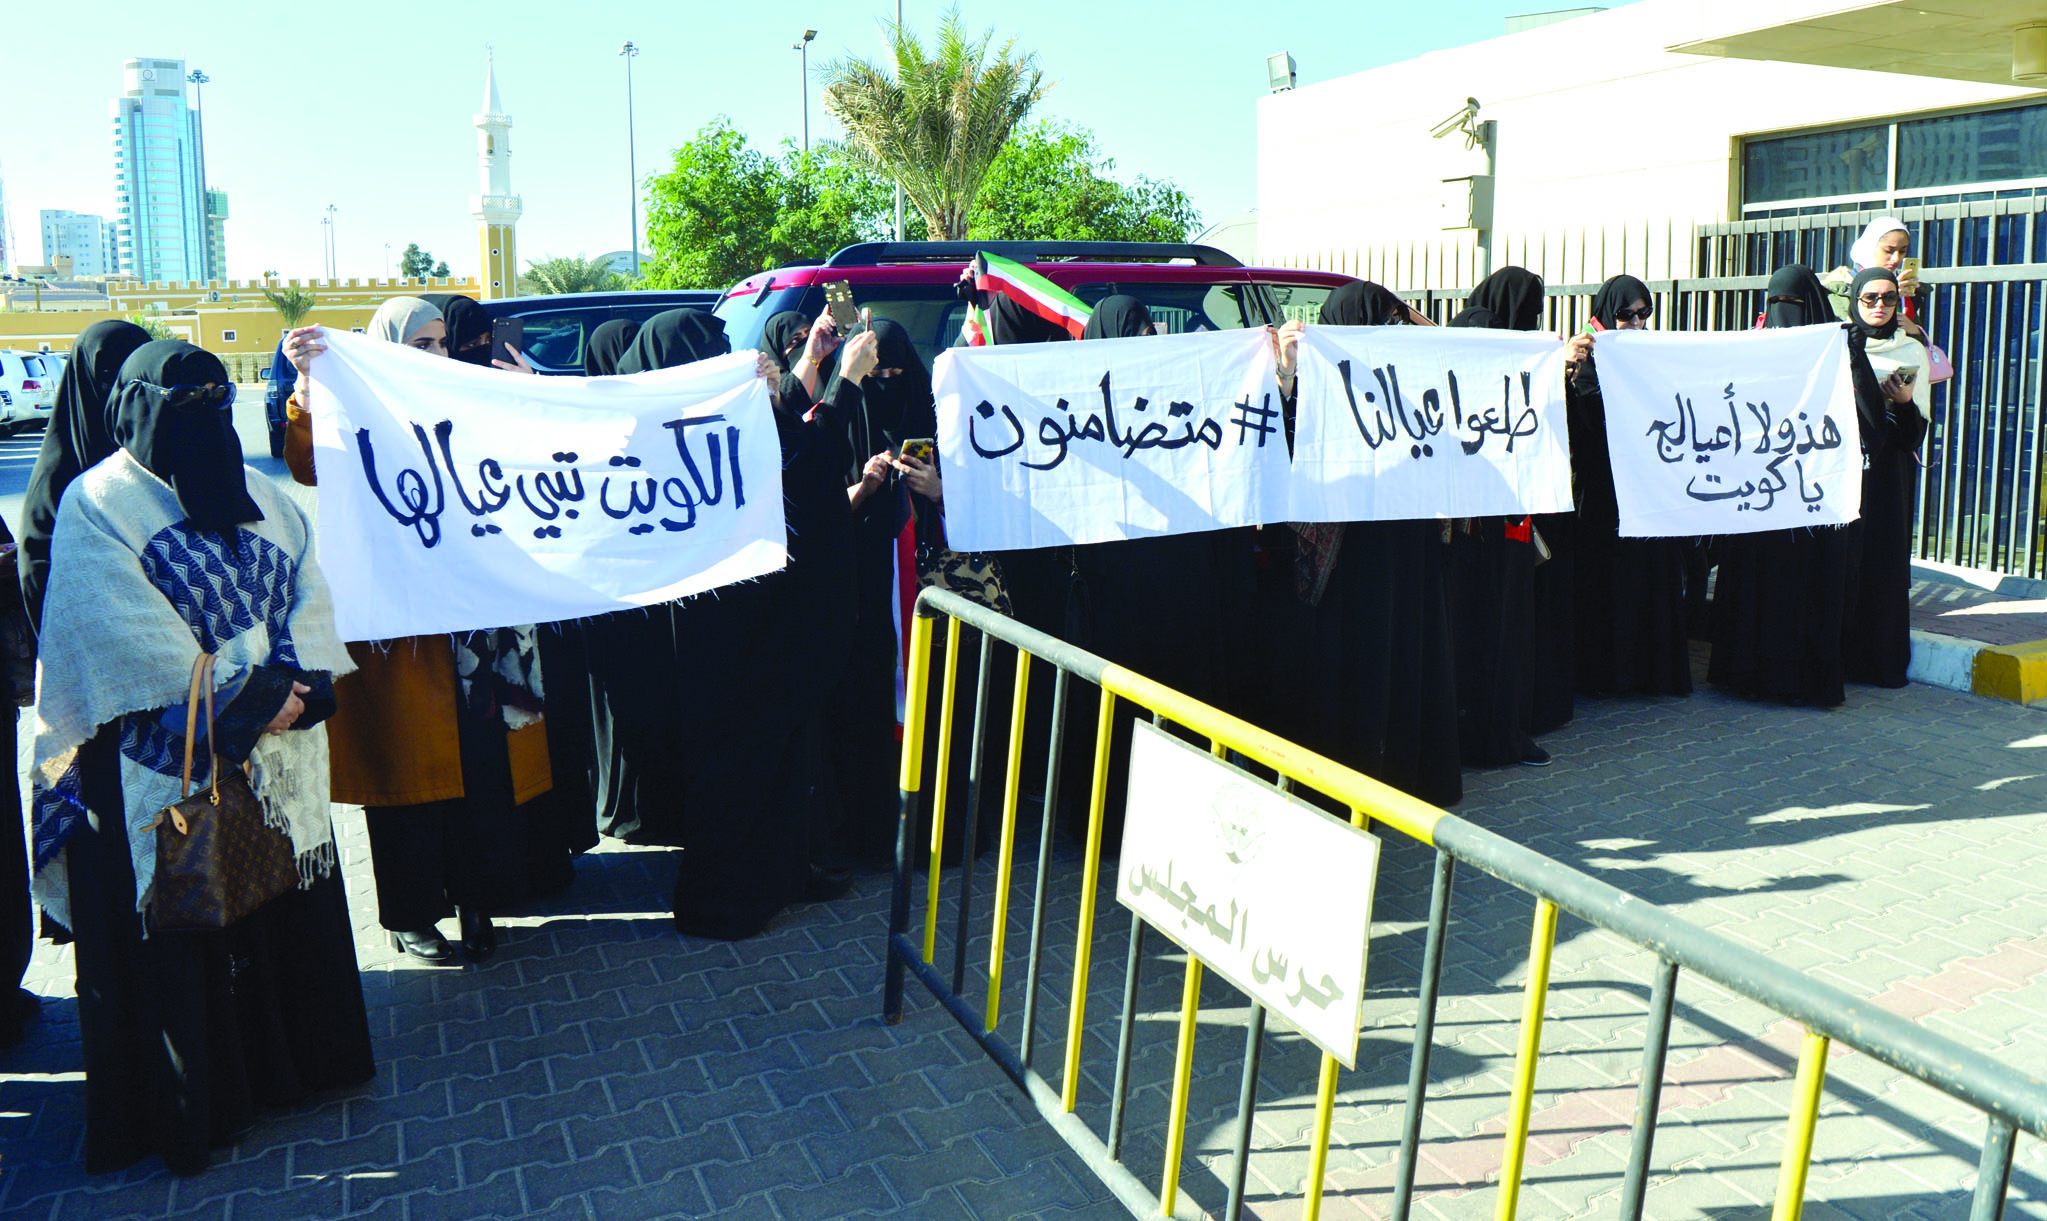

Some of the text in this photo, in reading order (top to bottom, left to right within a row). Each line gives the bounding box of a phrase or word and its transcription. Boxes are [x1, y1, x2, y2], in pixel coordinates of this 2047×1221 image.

[1337, 359, 1539, 460] طلعوا عيالنا
[355, 414, 747, 549] الكويت تبي عيالها
[1686, 453, 1824, 513] يا كويت
[1128, 859, 1345, 1011] حرس المجلس
